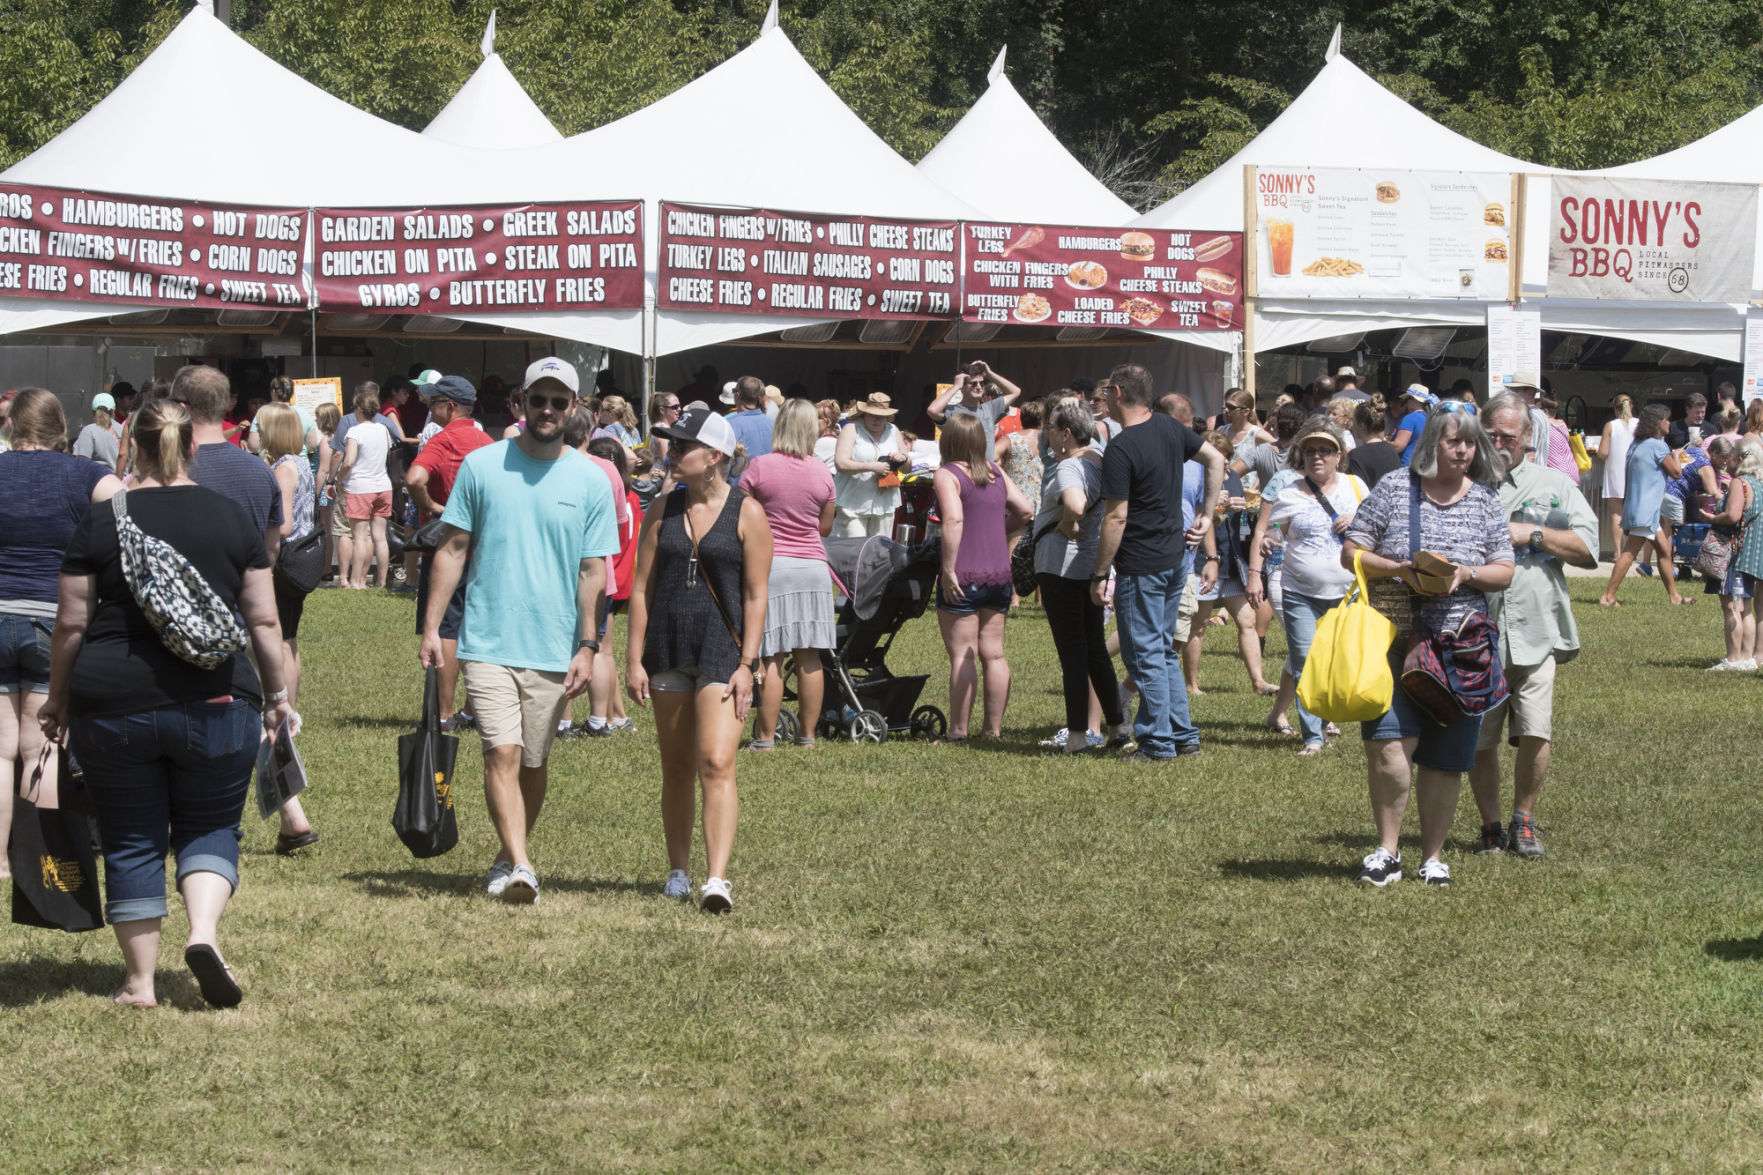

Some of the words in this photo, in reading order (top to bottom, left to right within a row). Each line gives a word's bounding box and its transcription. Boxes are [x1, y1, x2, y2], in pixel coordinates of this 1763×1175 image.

[1259, 174, 1316, 194] SONNY'S
[1263, 194, 1288, 208] BBQ
[63, 198, 183, 231] HAMBURGERS
[213, 211, 247, 236] HOT
[255, 214, 301, 241] DOGS
[322, 216, 394, 242] GARDEN
[403, 214, 473, 240] SALADS
[503, 211, 558, 237] GREEK
[567, 210, 636, 235] SALADS
[1560, 197, 1701, 248] SONNY'S
[668, 211, 714, 237] CHICKEN
[719, 216, 764, 240] FINGERS
[829, 223, 864, 246] PHILLY
[870, 224, 908, 249] CHEESE
[913, 227, 953, 251] STEAKS
[970, 226, 1011, 239] TURKEY
[979, 241, 1004, 252] LEGS
[1058, 236, 1121, 250] HAMBURGERS
[1171, 234, 1191, 246] HOT
[48, 232, 115, 260] FINGERS
[209, 244, 251, 271] CORN
[258, 248, 297, 275] DOGS
[322, 250, 396, 276] CHICKEN
[405, 249, 429, 273] ON
[437, 248, 477, 272] PITA
[505, 245, 559, 270] STEAK
[568, 244, 591, 268] ON
[600, 244, 637, 267] PITA
[1168, 247, 1194, 260] DOGS
[1639, 251, 1670, 259] LOCAL
[668, 244, 713, 269] TURKEY
[718, 247, 745, 272] LEGS
[764, 250, 808, 275] ITALIAN
[813, 253, 871, 279] SAUSAGES
[890, 257, 920, 281] CORN
[925, 260, 954, 283] DOGS
[974, 260, 1020, 273] CHICKEN
[1025, 262, 1068, 275] FINGERS
[1568, 248, 1634, 283] BBQ
[1638, 261, 1699, 270] PITMASTERS
[1144, 266, 1177, 279] PHILLY
[1638, 271, 1667, 279] SINCE
[1670, 273, 1686, 286] 68
[28, 265, 67, 291] FRIES
[90, 269, 151, 297] REGULAR
[159, 275, 199, 300] FRIES
[222, 279, 267, 303] SWEET
[272, 283, 301, 303] TEA
[990, 275, 1018, 287] WITH
[1024, 276, 1053, 288] FRIES
[1120, 279, 1158, 292] CHEESE
[1163, 280, 1202, 294] STEAKS
[356, 283, 421, 306] GYROS
[450, 279, 546, 305] BUTTERFLY
[556, 277, 604, 302] FRIES
[670, 277, 713, 303] CHEESE
[719, 280, 752, 305] FRIES
[771, 284, 823, 308] REGULAR
[829, 287, 862, 311] FRIES
[881, 290, 923, 312] SWEET
[928, 292, 949, 314] TEA
[968, 294, 1019, 307] BUTTERFLY
[1075, 297, 1113, 310] LOADED
[1171, 301, 1207, 312] SWEET
[977, 308, 1008, 321] FRIES
[1058, 311, 1096, 323] CHEESE
[1101, 311, 1129, 325] FRIES
[1180, 314, 1198, 327] TEA
